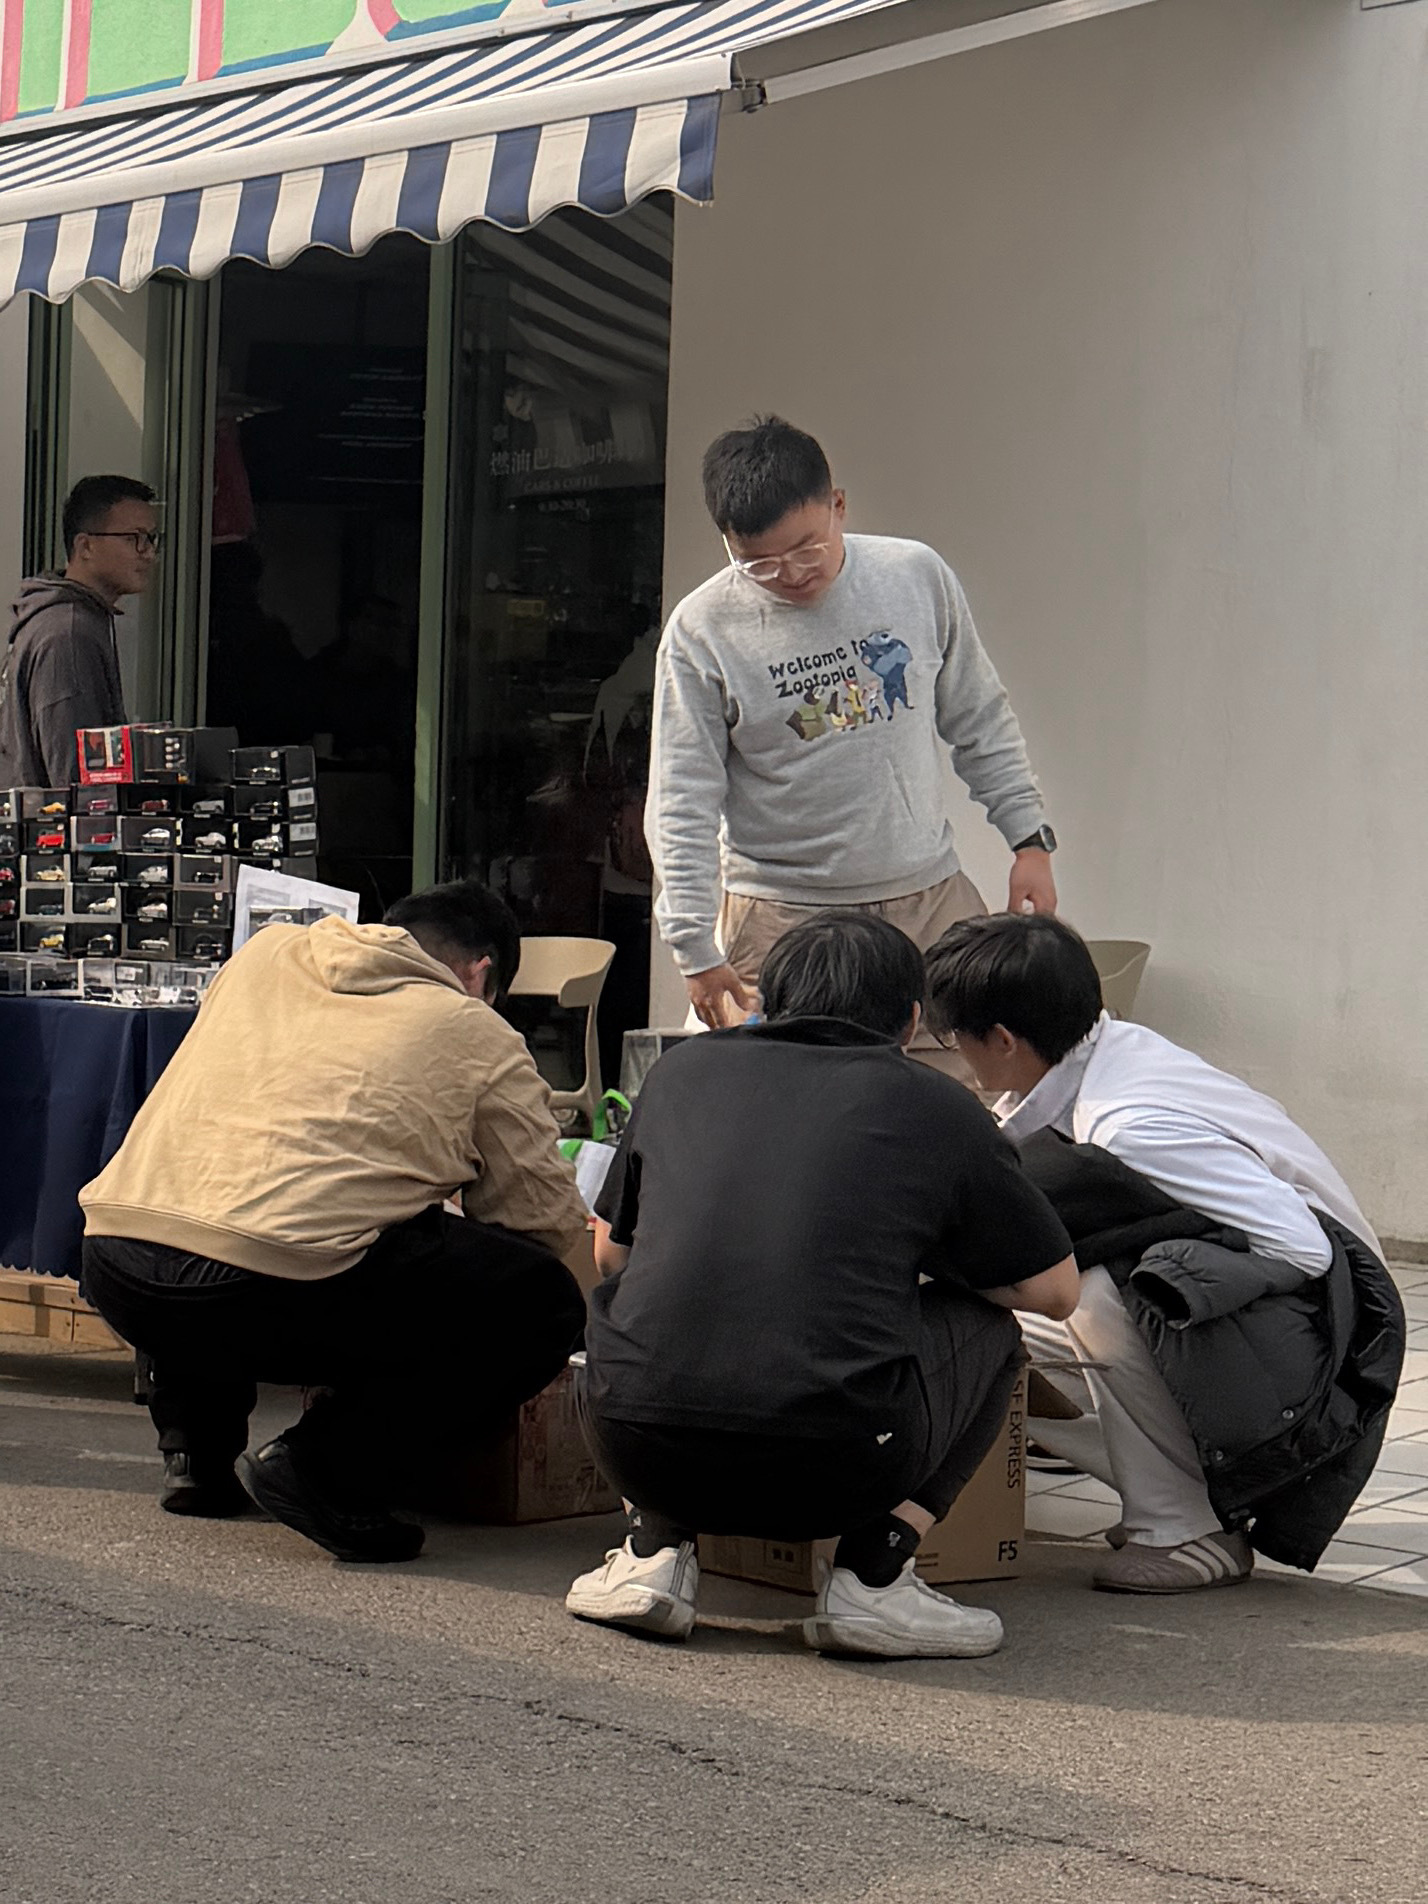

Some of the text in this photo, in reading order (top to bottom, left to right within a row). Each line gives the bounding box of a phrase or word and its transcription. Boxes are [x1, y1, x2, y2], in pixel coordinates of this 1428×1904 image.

[768, 646, 847, 679] Welcome
[775, 664, 857, 699] Zootopia
[1007, 1379, 1024, 1489] SF EXPRESS
[997, 1540, 1018, 1562] F5
